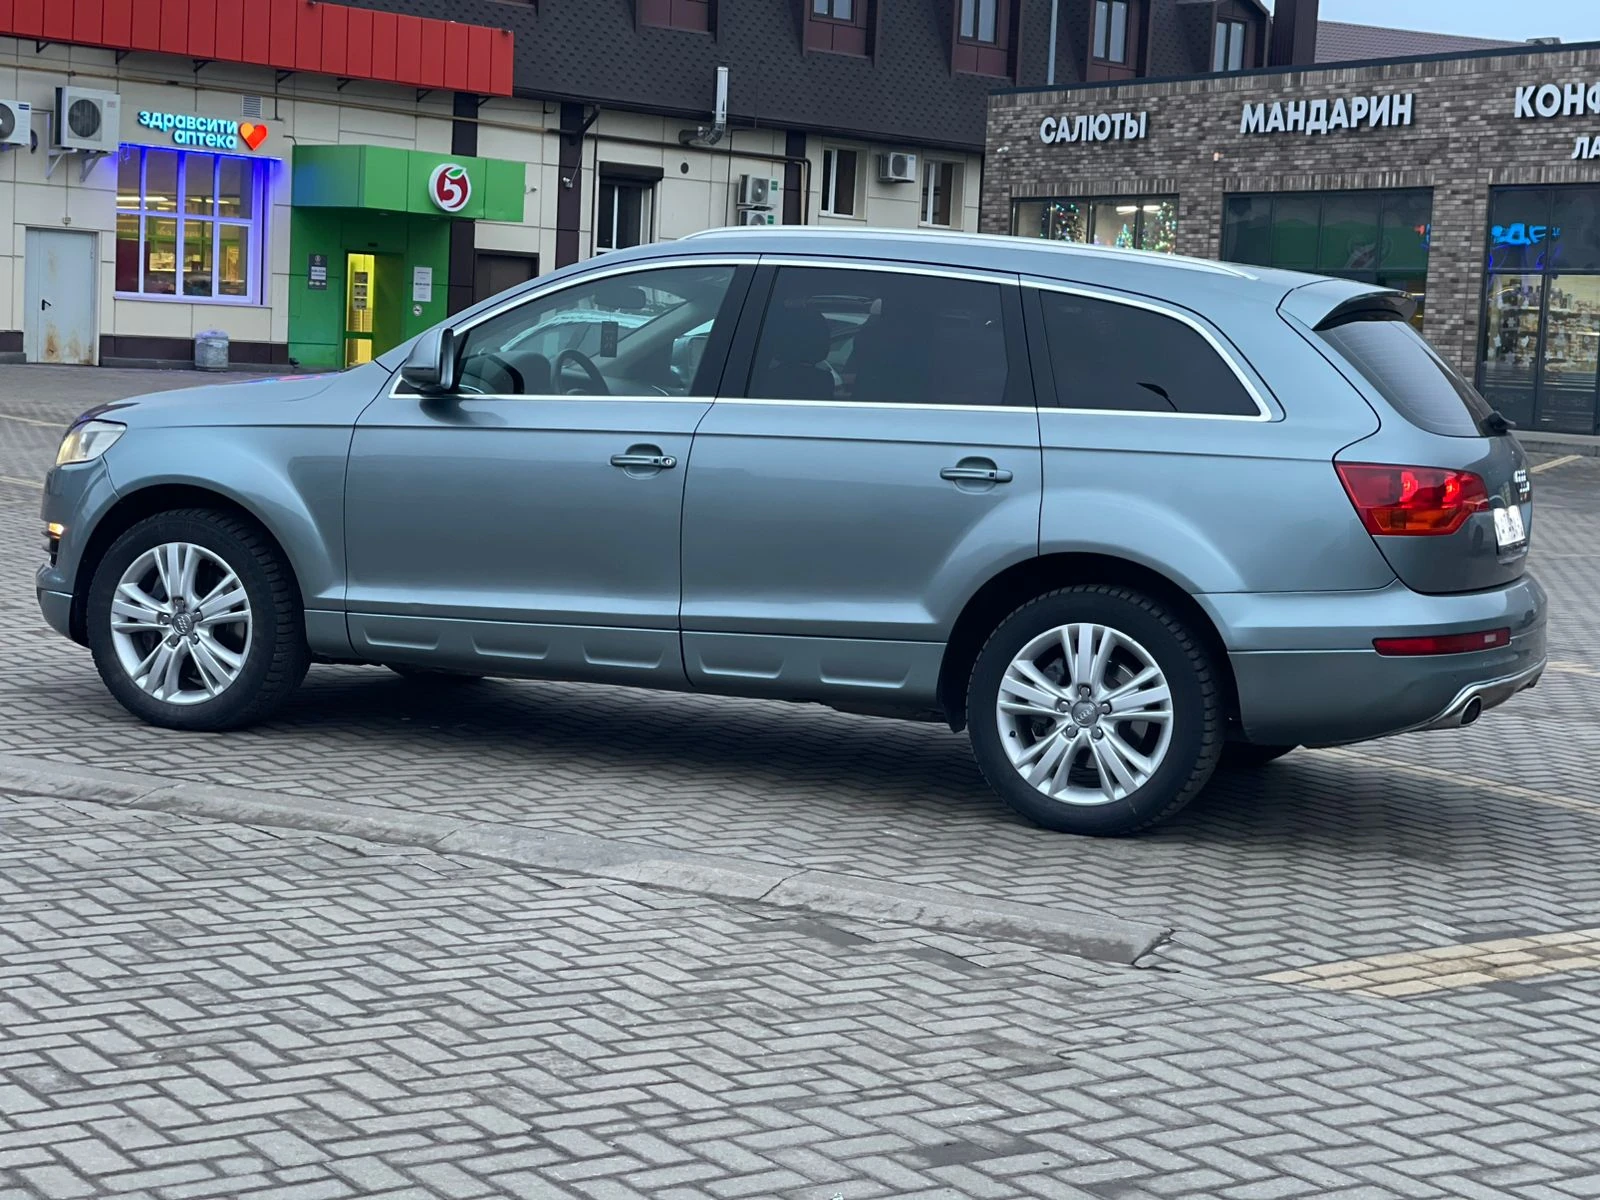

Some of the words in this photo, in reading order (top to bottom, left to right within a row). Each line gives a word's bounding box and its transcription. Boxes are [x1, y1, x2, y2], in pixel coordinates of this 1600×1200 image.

[138, 110, 238, 134] здравсити
[1039, 111, 1148, 144] САЛЮТЫ
[1239, 93, 1413, 136] МАНДАРИН
[173, 129, 237, 149] аптека
